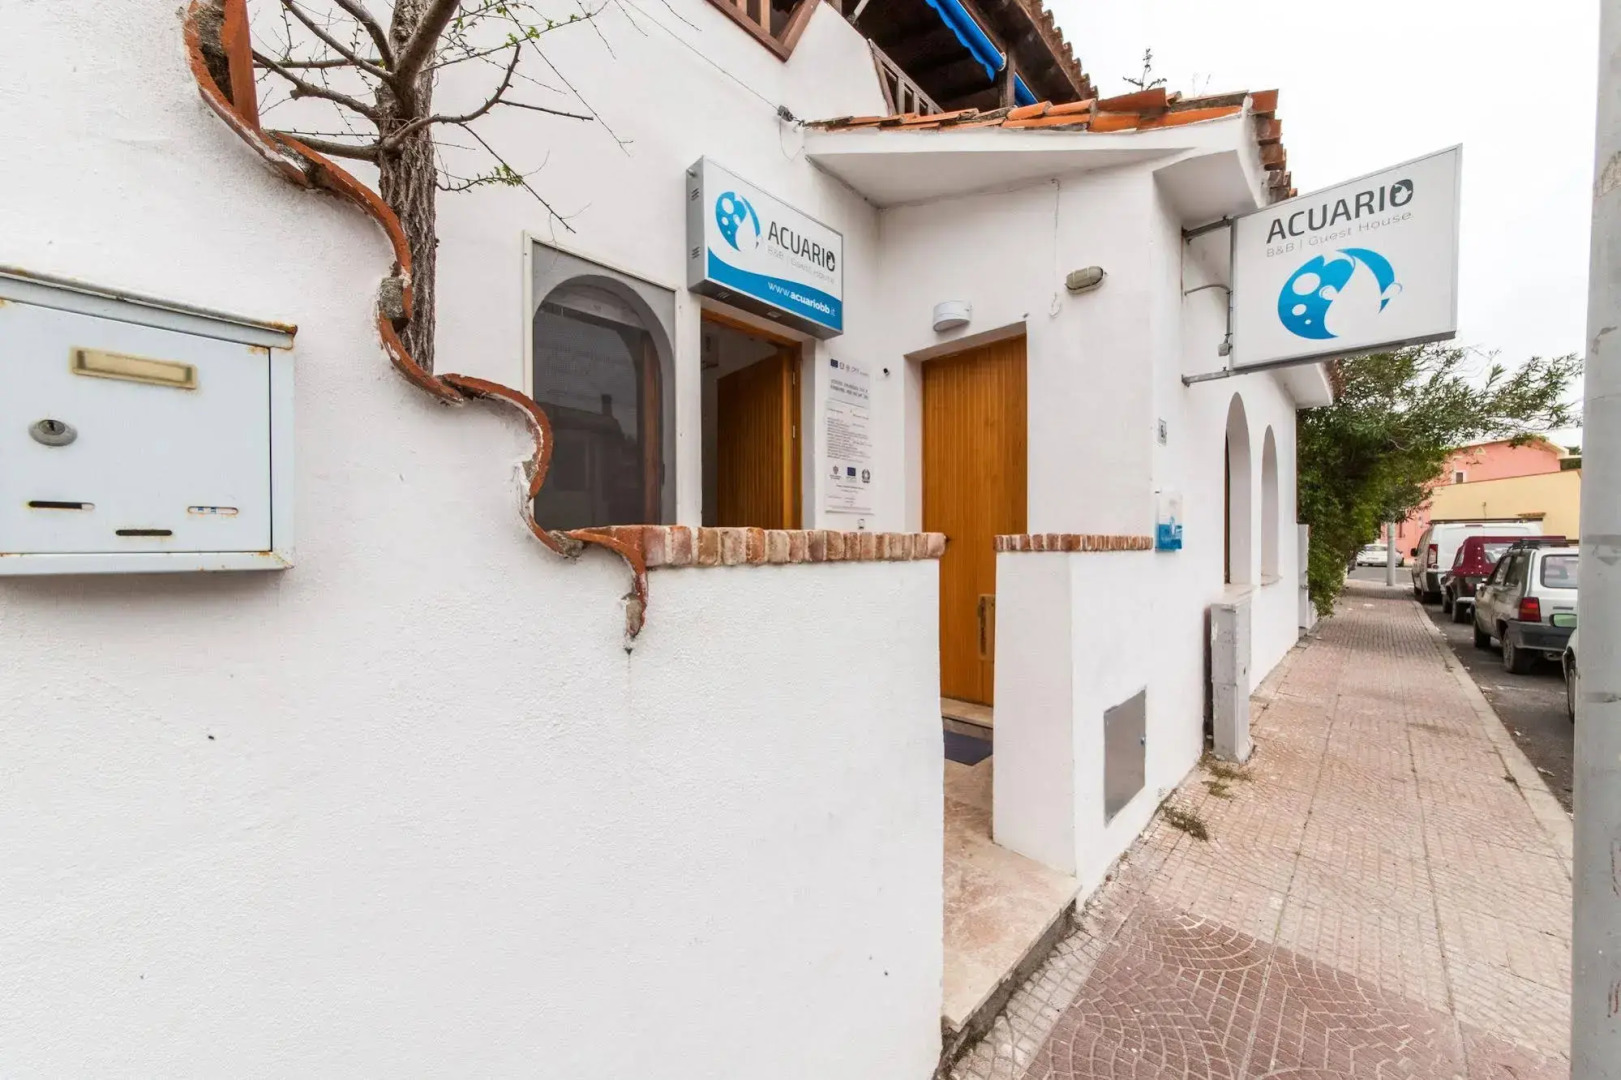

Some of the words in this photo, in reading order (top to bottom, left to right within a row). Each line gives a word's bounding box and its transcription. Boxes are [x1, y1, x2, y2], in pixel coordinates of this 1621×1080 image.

[1266, 178, 1414, 244] ACUARIO
[1266, 242, 1295, 258] B&B
[1308, 227, 1353, 246] Guest
[1358, 211, 1413, 232] House
[768, 220, 836, 272] ACUARIO
[767, 281, 836, 317] www.acuariobb.it
